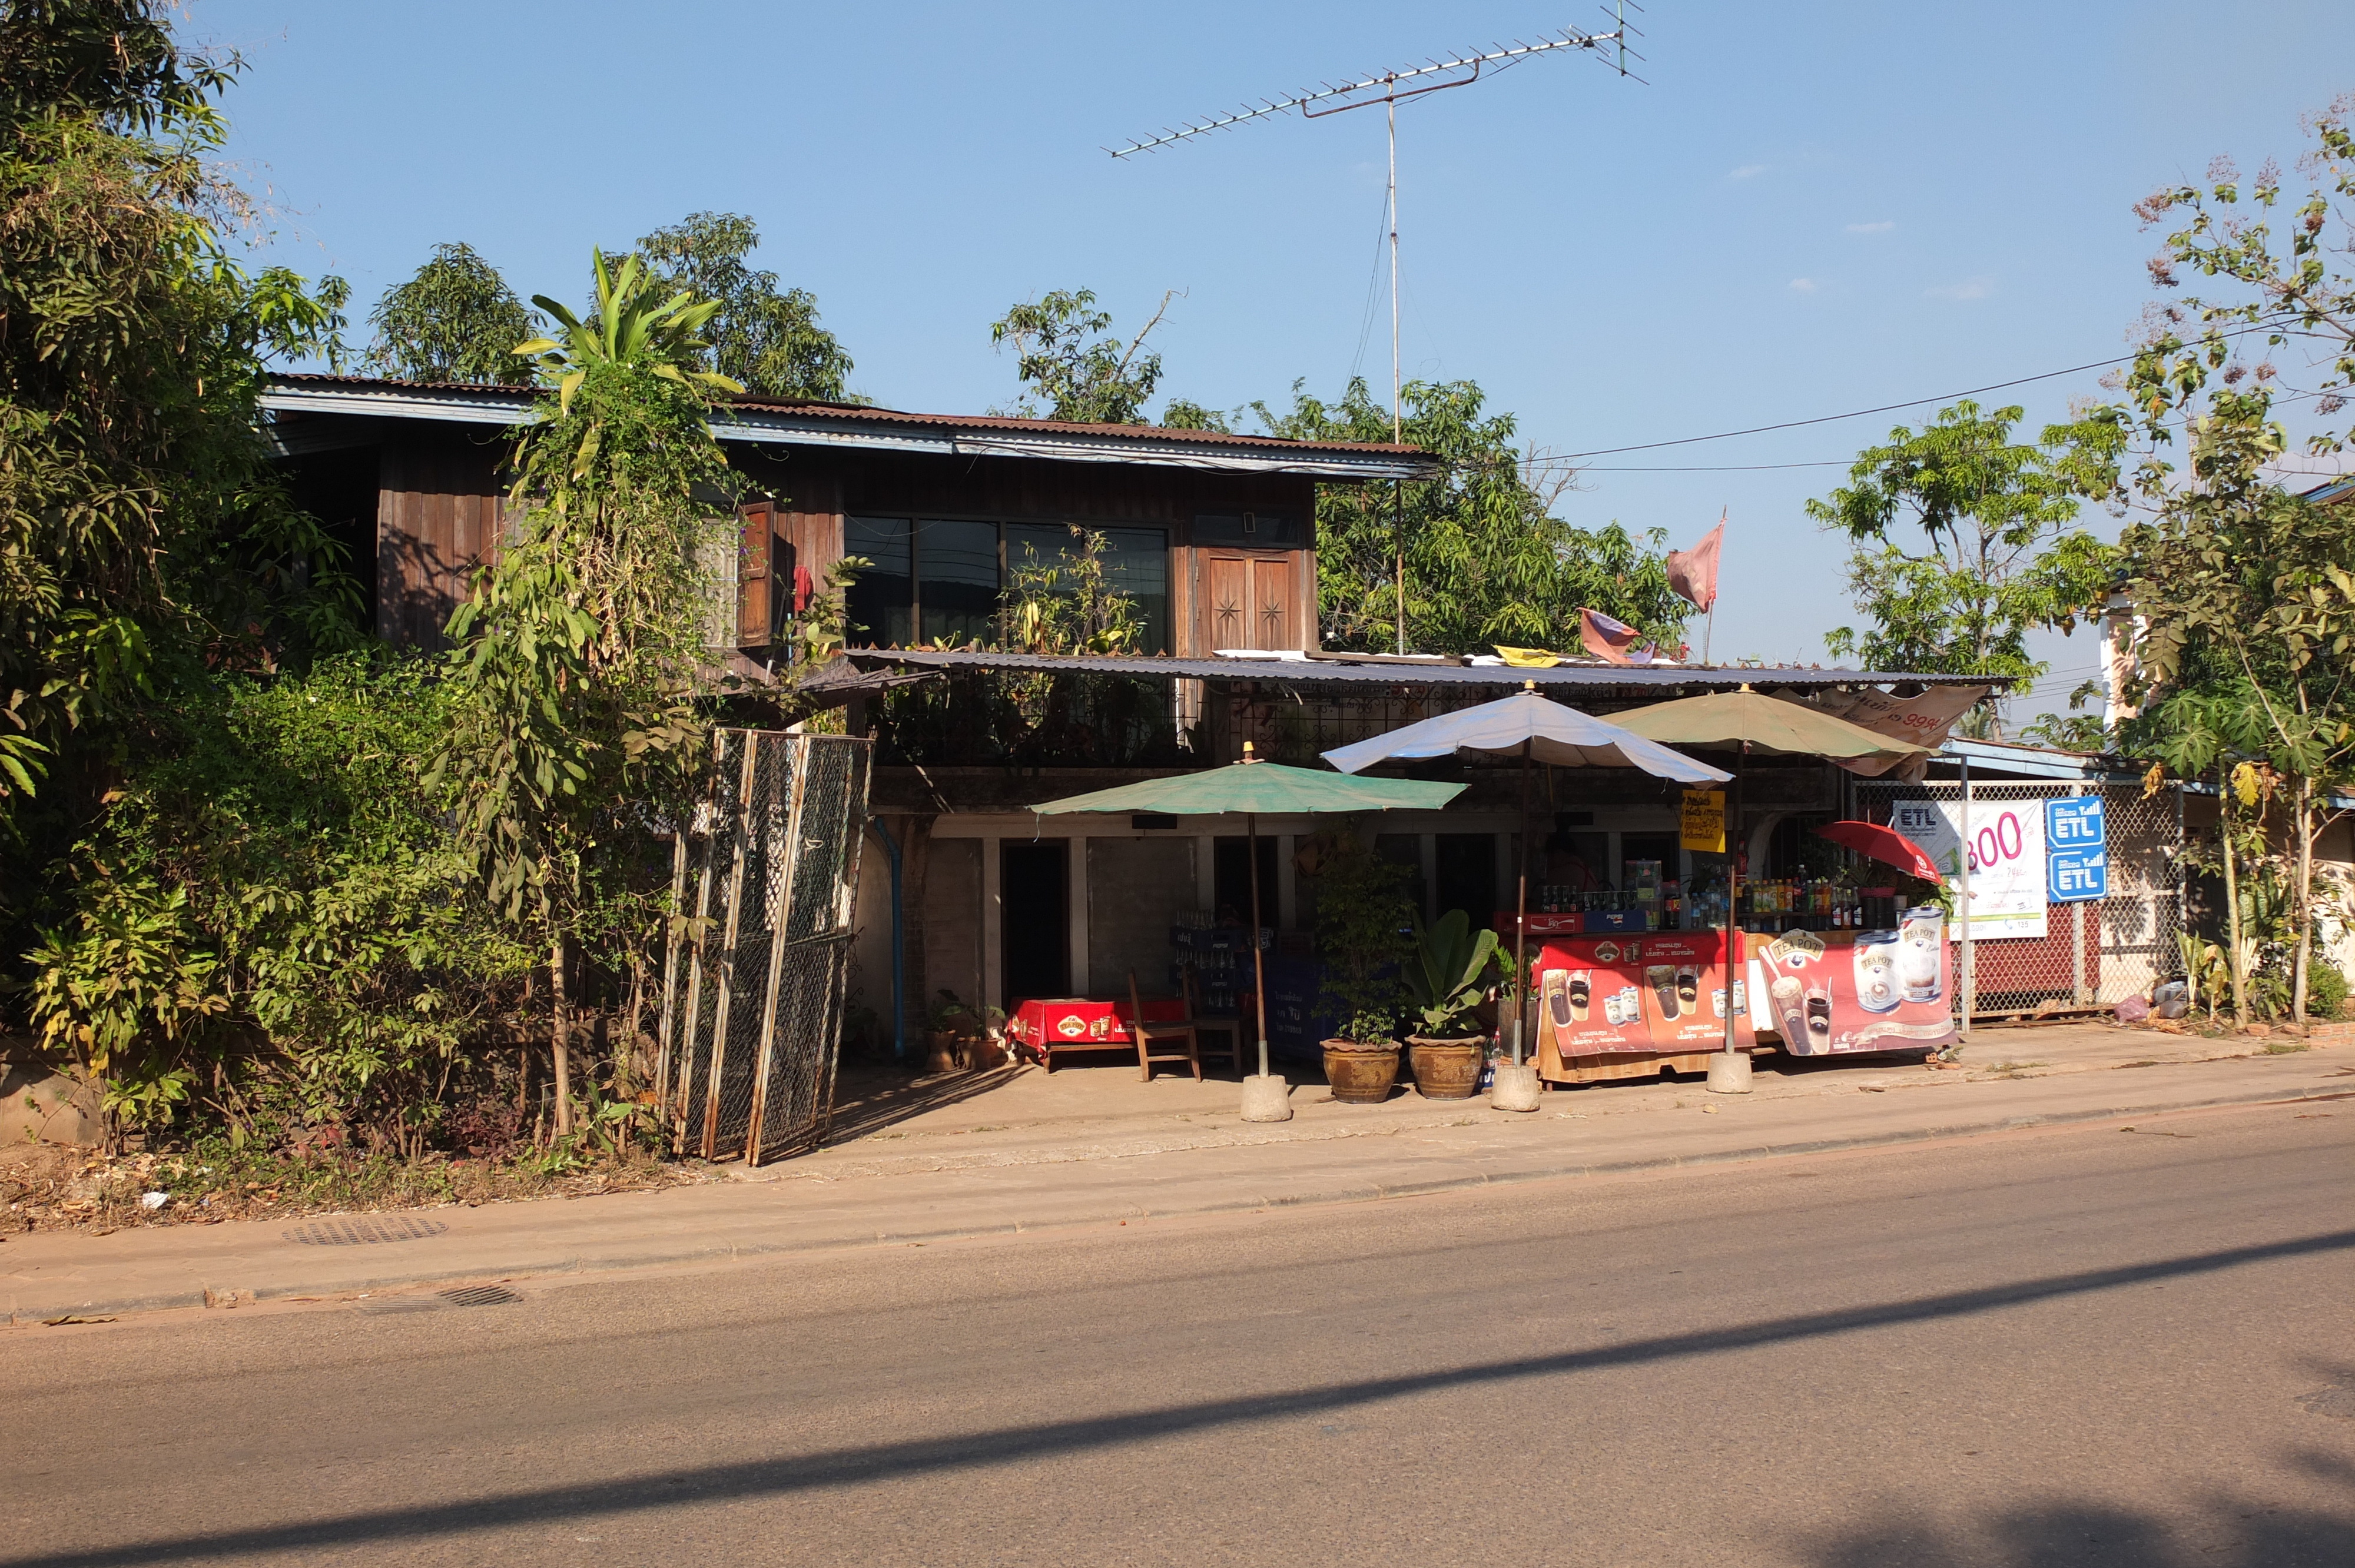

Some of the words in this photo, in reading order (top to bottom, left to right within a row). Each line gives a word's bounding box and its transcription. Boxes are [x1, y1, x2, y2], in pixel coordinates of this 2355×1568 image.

[1903, 713, 1941, 730] 99%
[1900, 809, 1936, 826] ETL
[2055, 816, 2094, 838] ETL
[2058, 868, 2098, 890] ETL
[1905, 929, 1918, 939] TEA
[1920, 929, 1934, 938] POT
[1774, 941, 1795, 955] TEA
[1797, 938, 1821, 953] POT
[1863, 958, 1876, 967] TEA
[1878, 956, 1891, 965] POT
